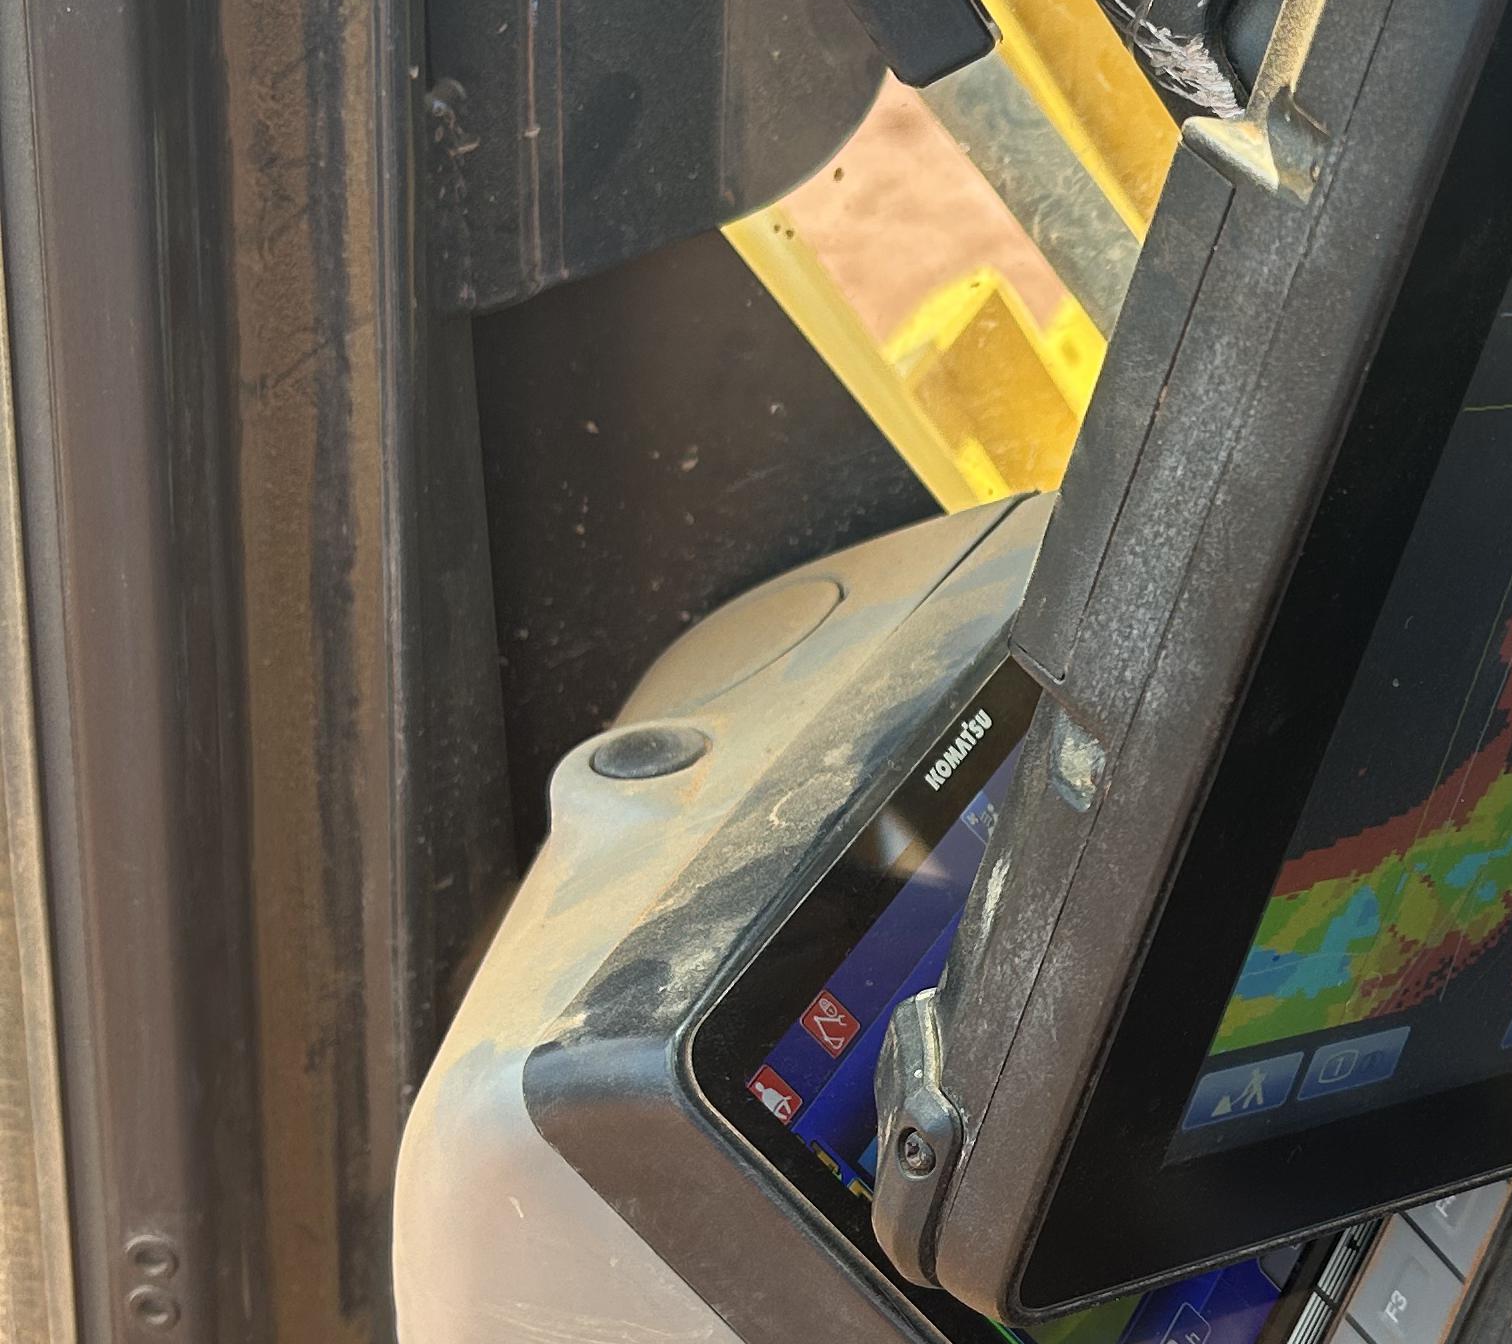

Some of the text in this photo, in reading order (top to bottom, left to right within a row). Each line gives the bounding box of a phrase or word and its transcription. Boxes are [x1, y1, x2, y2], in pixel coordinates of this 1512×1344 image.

[924, 709, 993, 791] KOMATSU
[1434, 1195, 1457, 1218] F
[1383, 1289, 1408, 1323] F3
